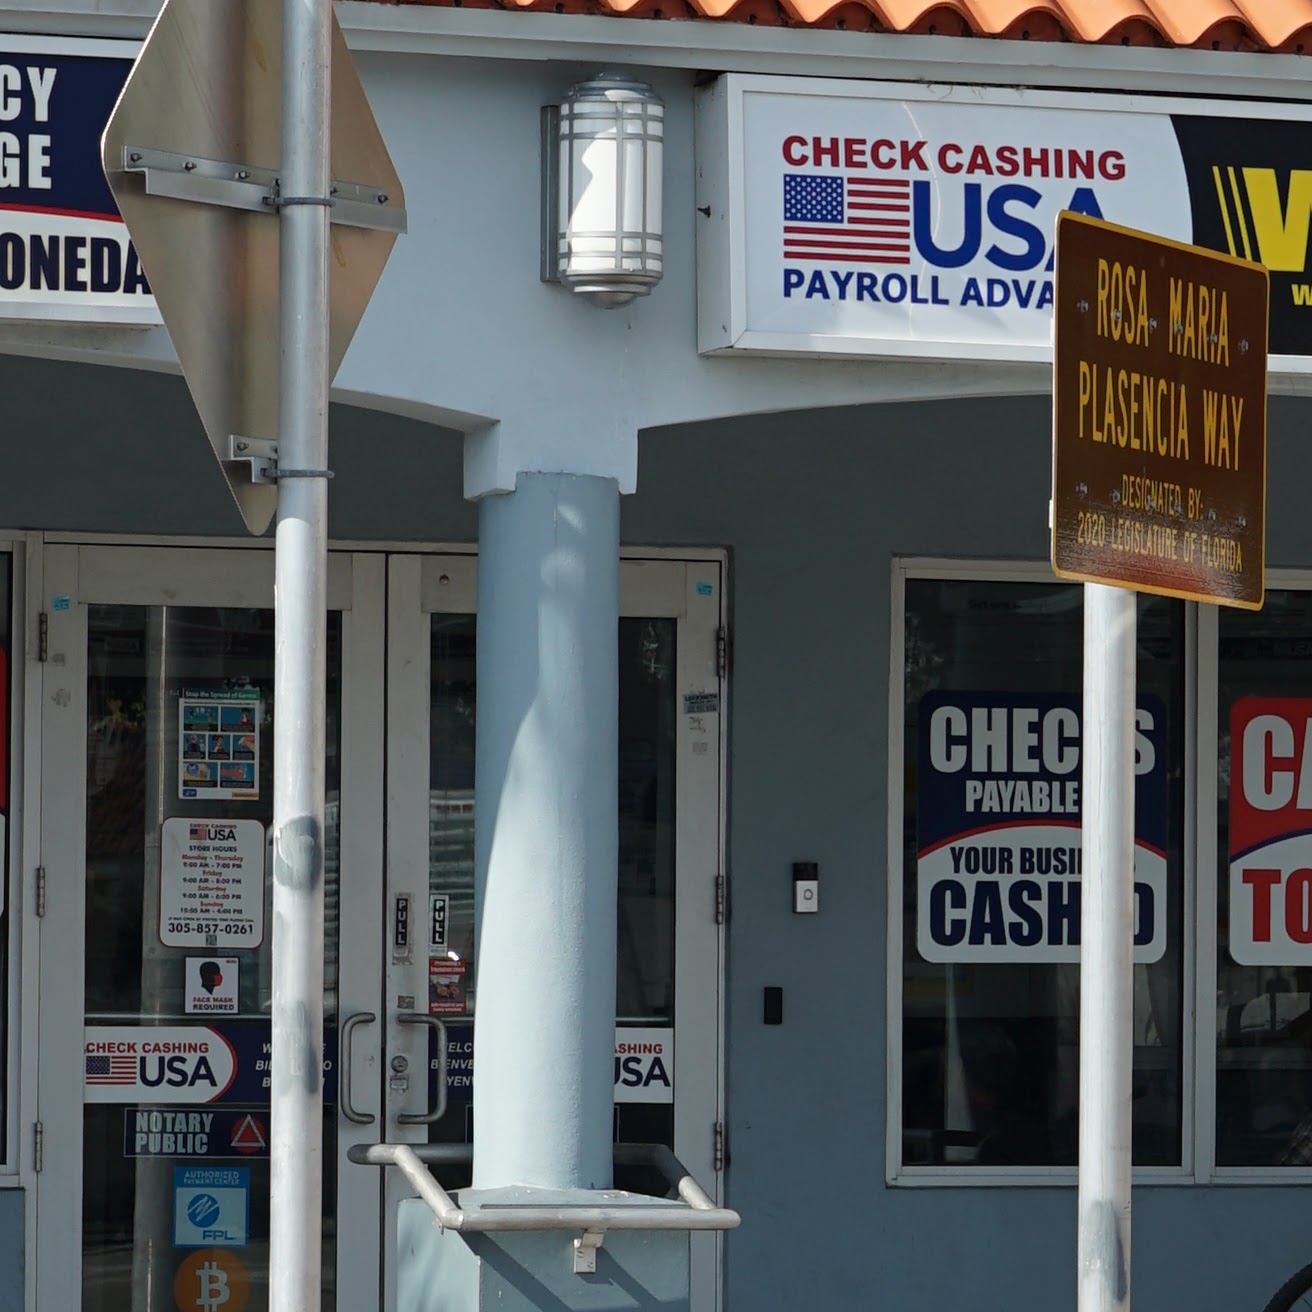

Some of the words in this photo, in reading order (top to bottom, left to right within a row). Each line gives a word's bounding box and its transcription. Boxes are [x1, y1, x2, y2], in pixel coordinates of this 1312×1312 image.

[782, 135, 928, 171] CHECK
[937, 143, 1126, 181] CASHING
[783, 268, 949, 306] PAYROLL
[960, 278, 1053, 310] ADVA
[1097, 258, 1150, 348] ROSA
[1168, 276, 1230, 367] MARIA
[1079, 360, 1190, 461] PLASENCIA
[1202, 389, 1244, 471] WAY
[1121, 473, 1182, 516] DESIGNATED
[1188, 488, 1204, 521] BY:
[1077, 511, 1105, 547] 2020
[1111, 520, 1178, 564] LEGISLATURE
[1183, 534, 1197, 565] OF
[1200, 537, 1243, 573] FLORIDA
[930, 705, 1156, 775] CHECS
[965, 780, 1080, 813] PAYABLE
[208, 829, 237, 841] USA
[950, 846, 1013, 874] YOUR
[168, 922, 253, 935] 305-857-0261
[398, 900, 407, 944] PULL
[435, 900, 444, 942] PULL
[930, 879, 1155, 947] CASHD
[86, 1042, 137, 1054] CHECK
[142, 1042, 209, 1054] CASHING
[615, 1043, 663, 1054] SHING
[139, 1056, 217, 1087] USA
[135, 1112, 214, 1133] NOTARY
[135, 1133, 208, 1154] PUBLIC
[184, 1170, 239, 1179] AUTHORIZED
[203, 1230, 237, 1240] FPL
